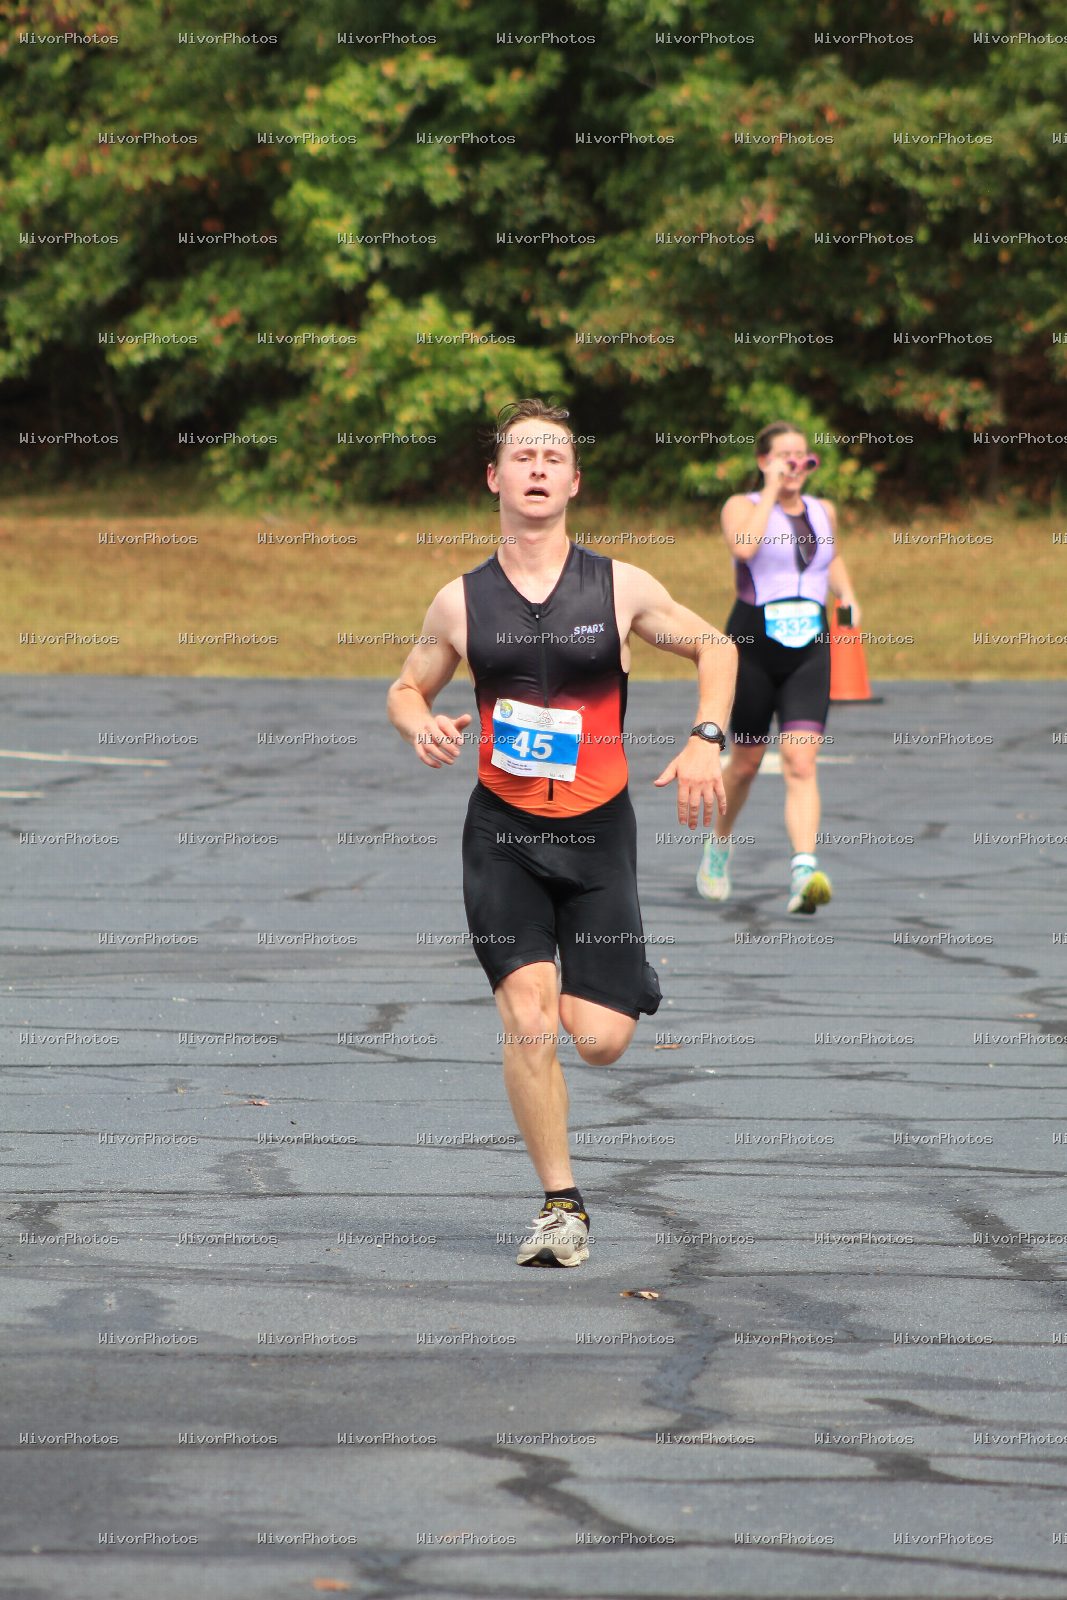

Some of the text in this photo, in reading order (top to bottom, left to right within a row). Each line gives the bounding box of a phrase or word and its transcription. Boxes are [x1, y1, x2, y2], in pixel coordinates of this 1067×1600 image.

[574, 623, 605, 635] SPARX
[775, 617, 811, 636] 332
[511, 730, 553, 760] 45
